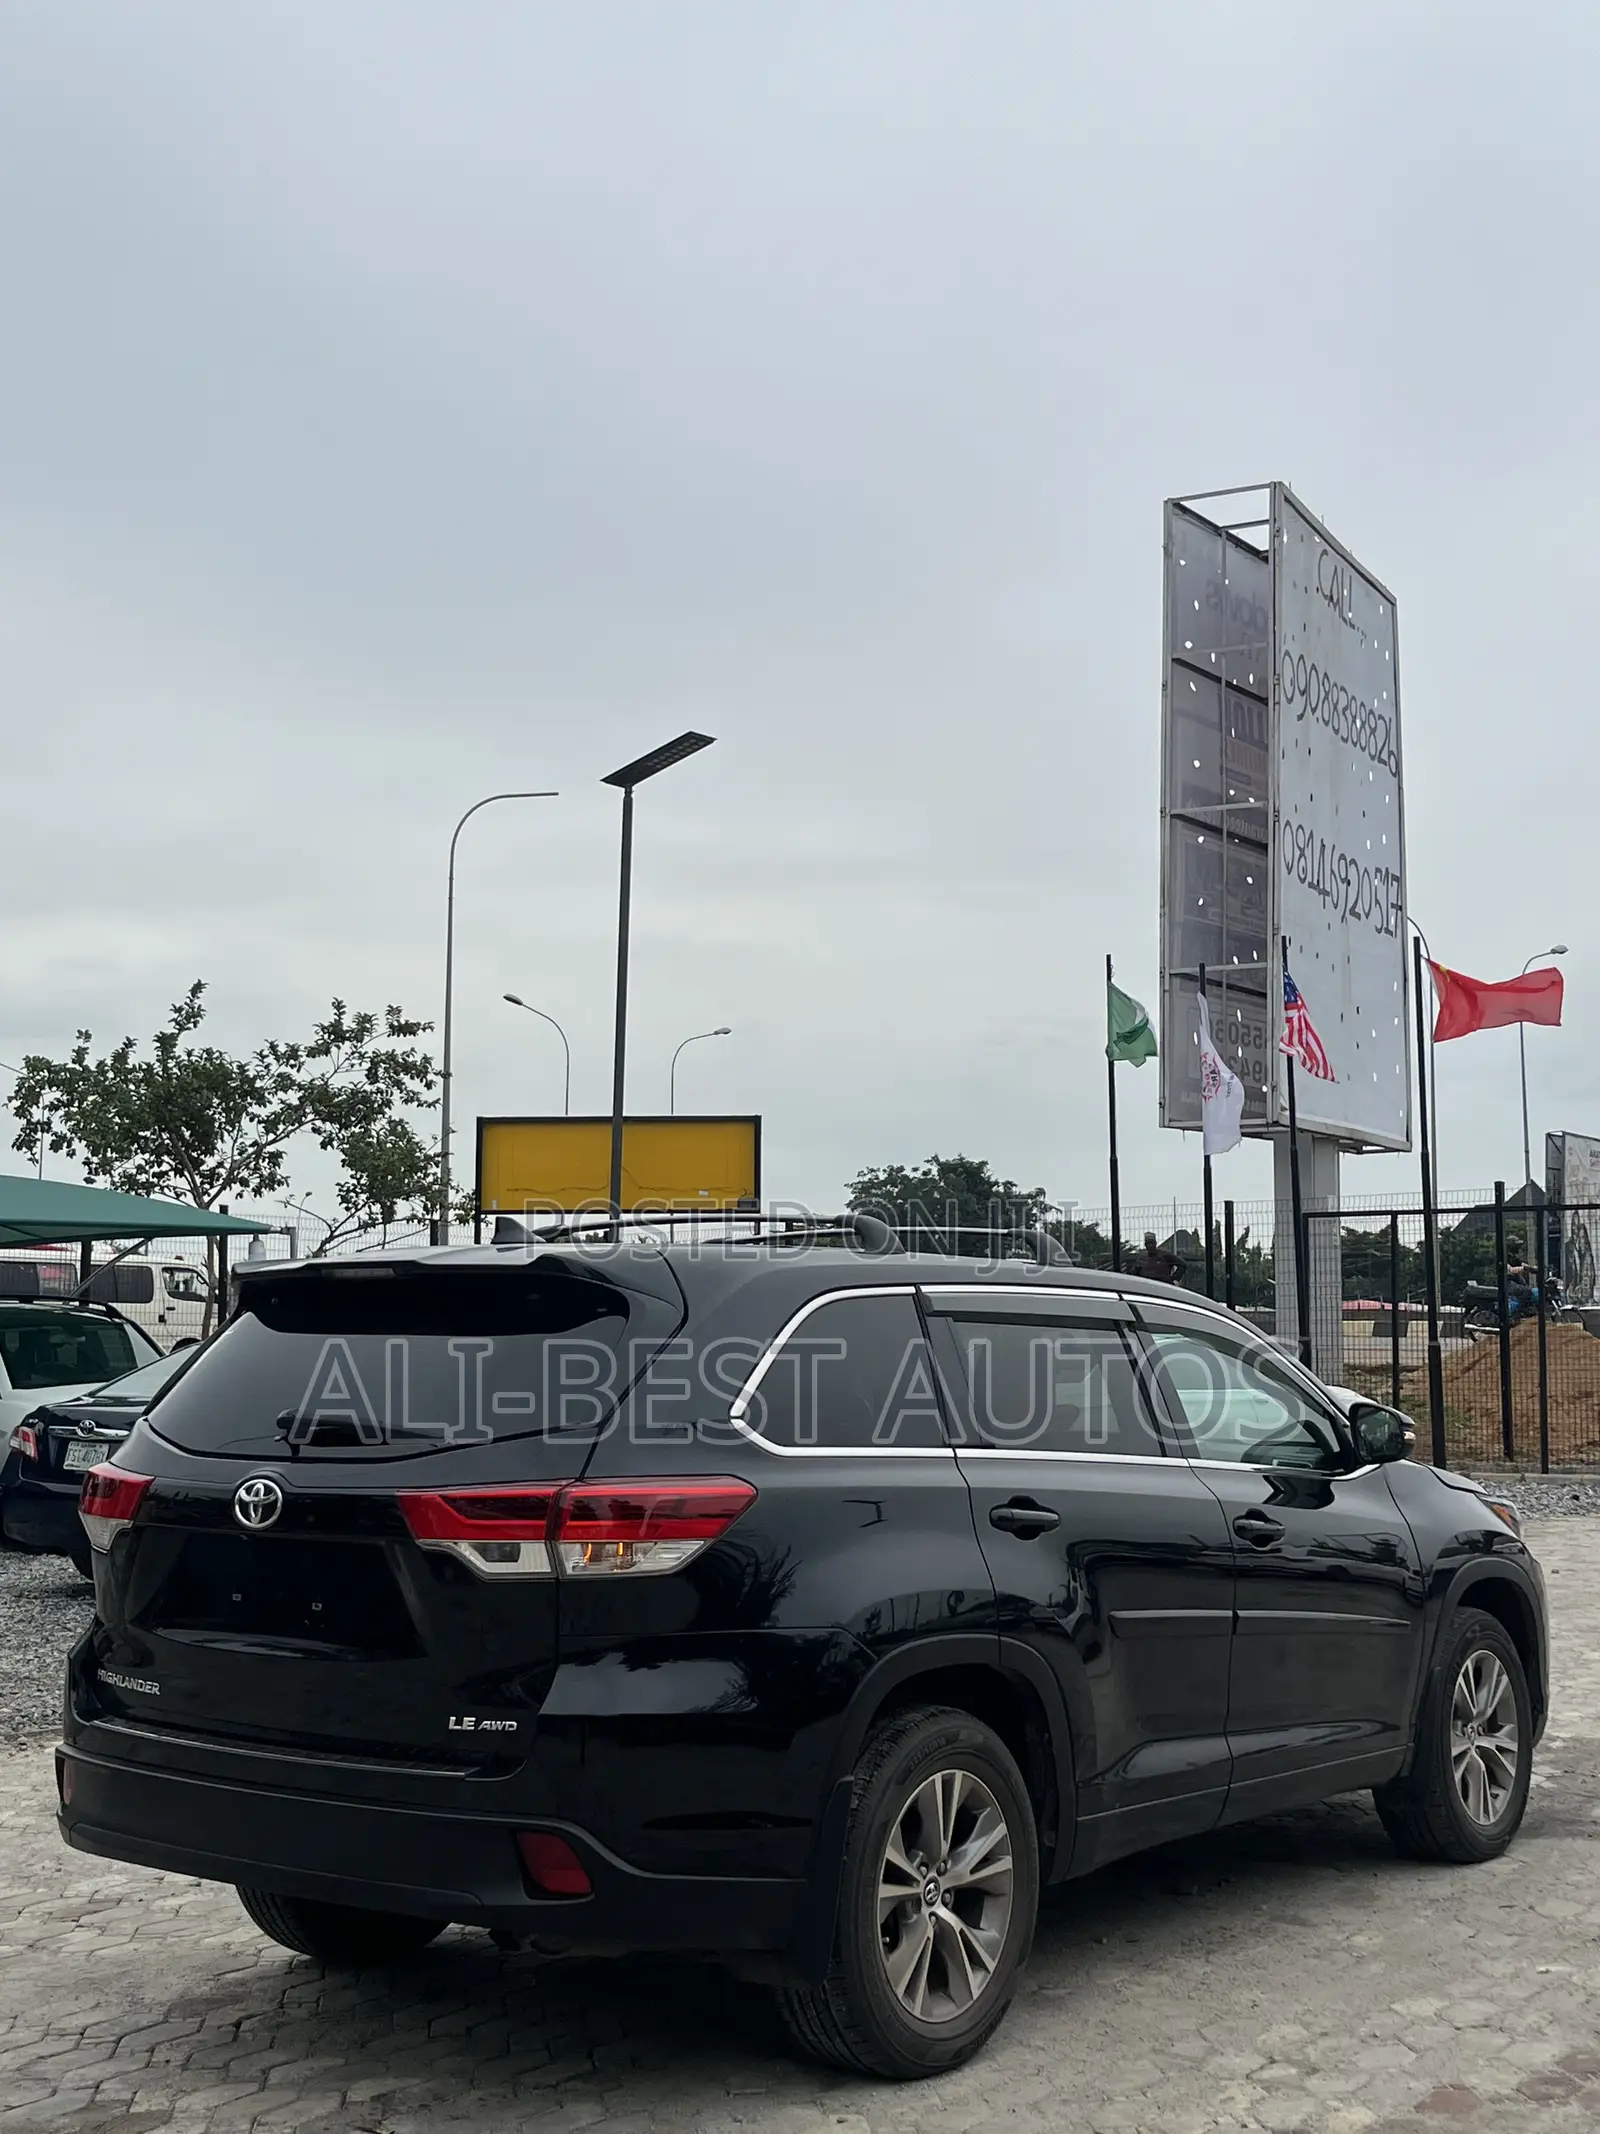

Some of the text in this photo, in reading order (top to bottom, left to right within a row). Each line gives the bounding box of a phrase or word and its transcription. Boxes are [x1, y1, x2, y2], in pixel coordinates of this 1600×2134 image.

[1283, 819, 1402, 939] 08146920517
[97, 1668, 160, 1695] HIGHLANDER
[448, 1716, 518, 1731] LE AWD
